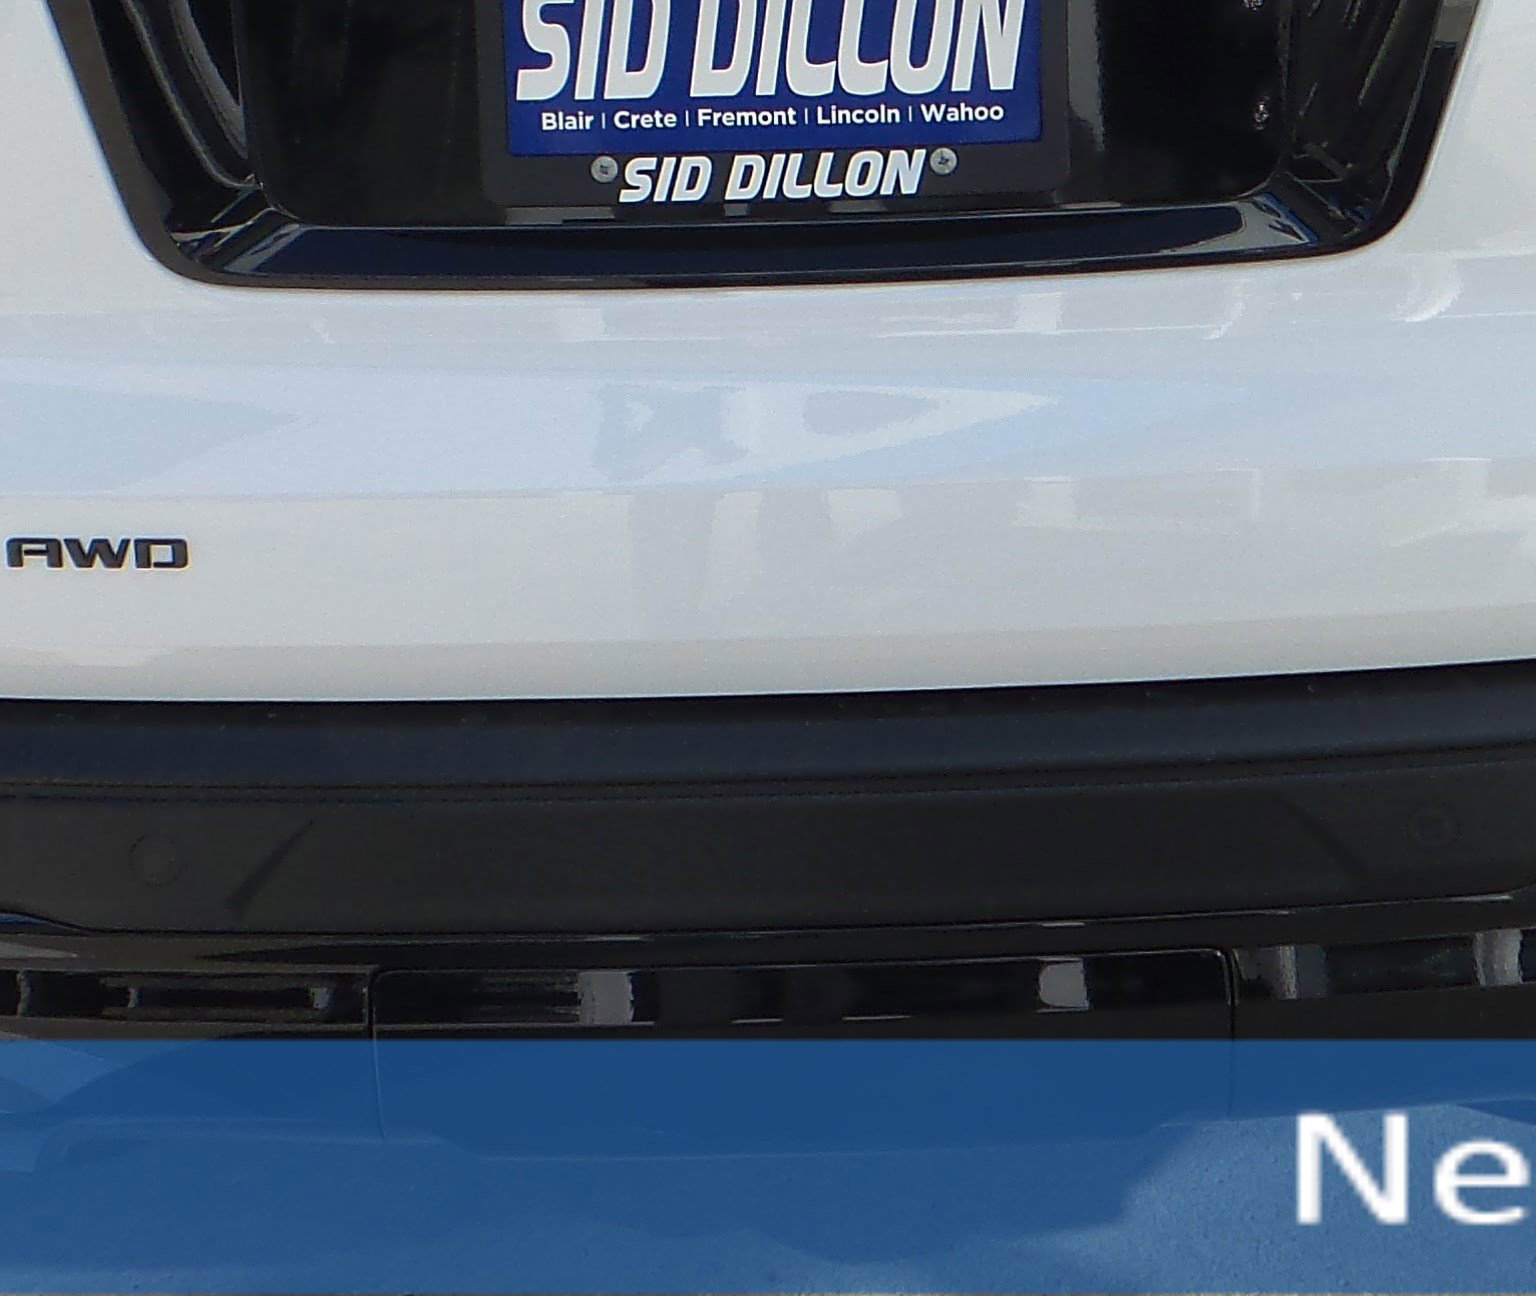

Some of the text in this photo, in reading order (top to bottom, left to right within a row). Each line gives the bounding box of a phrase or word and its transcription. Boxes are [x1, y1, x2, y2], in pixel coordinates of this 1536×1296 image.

[541, 102, 1005, 131] Blair Crete Fremont Lincoln Wahoo
[618, 148, 927, 203] SID DILLON
[5, 536, 190, 570] AWD
